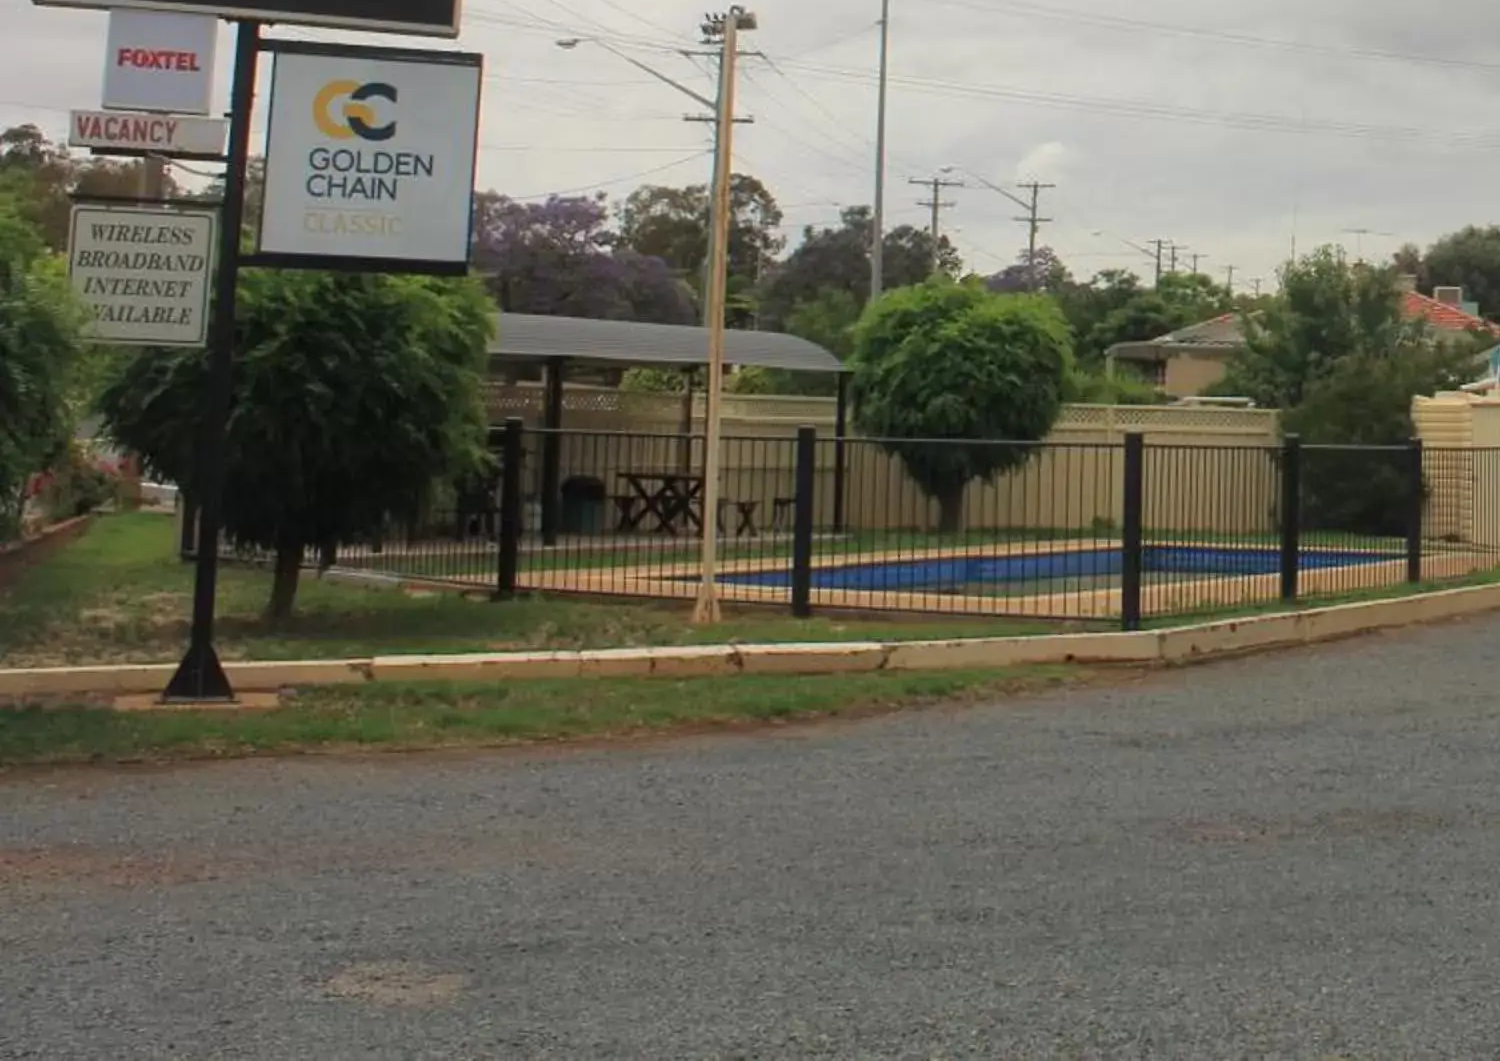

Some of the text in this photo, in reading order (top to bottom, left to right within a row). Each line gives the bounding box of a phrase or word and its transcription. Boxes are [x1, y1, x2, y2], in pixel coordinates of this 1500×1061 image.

[117, 48, 200, 72] FOXTEL
[77, 115, 177, 144] VACANCY
[308, 147, 434, 177] GOLDEN
[305, 173, 398, 200] CHAIN
[90, 223, 195, 245] WIRELESS
[302, 211, 403, 234] CLASSIC
[76, 250, 204, 272] BROADBAND
[83, 276, 192, 298] INTERNET
[90, 303, 193, 326] VAILABLE
